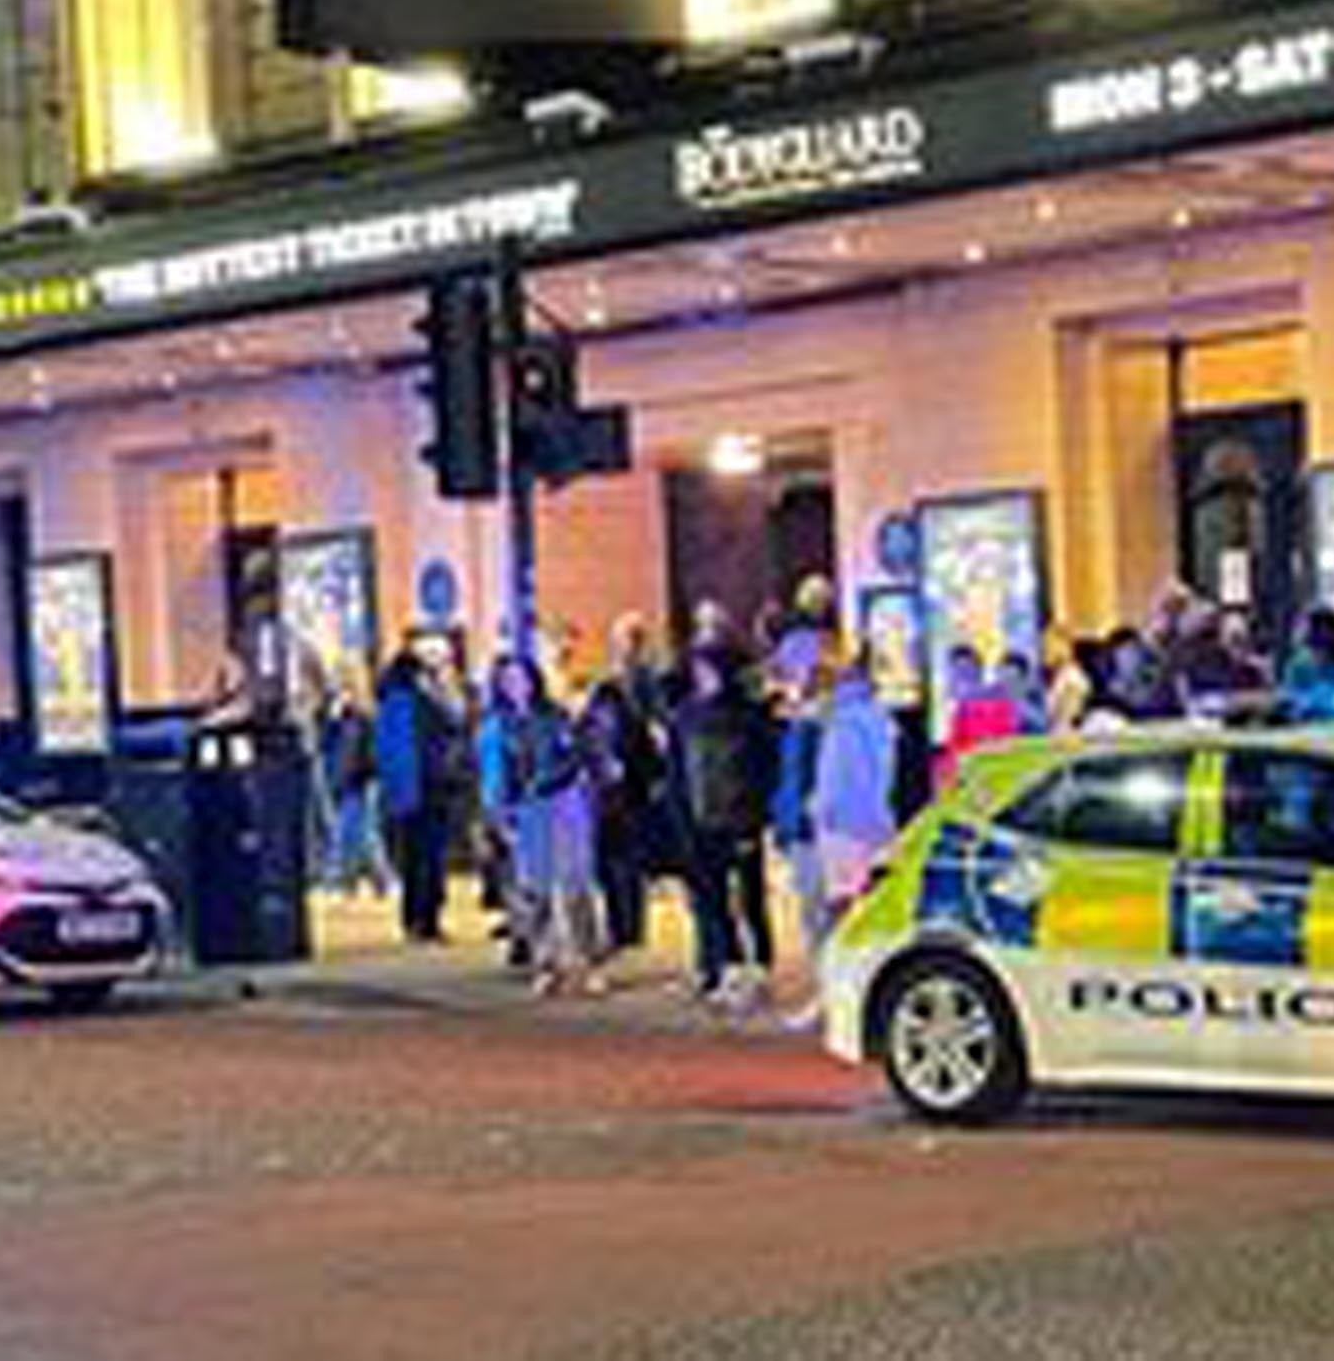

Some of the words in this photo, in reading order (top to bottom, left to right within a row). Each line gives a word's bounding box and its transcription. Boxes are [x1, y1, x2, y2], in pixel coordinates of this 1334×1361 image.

[1051, 62, 1164, 132] MON
[1168, 57, 1203, 109] 3
[1234, 29, 1330, 95] SAT
